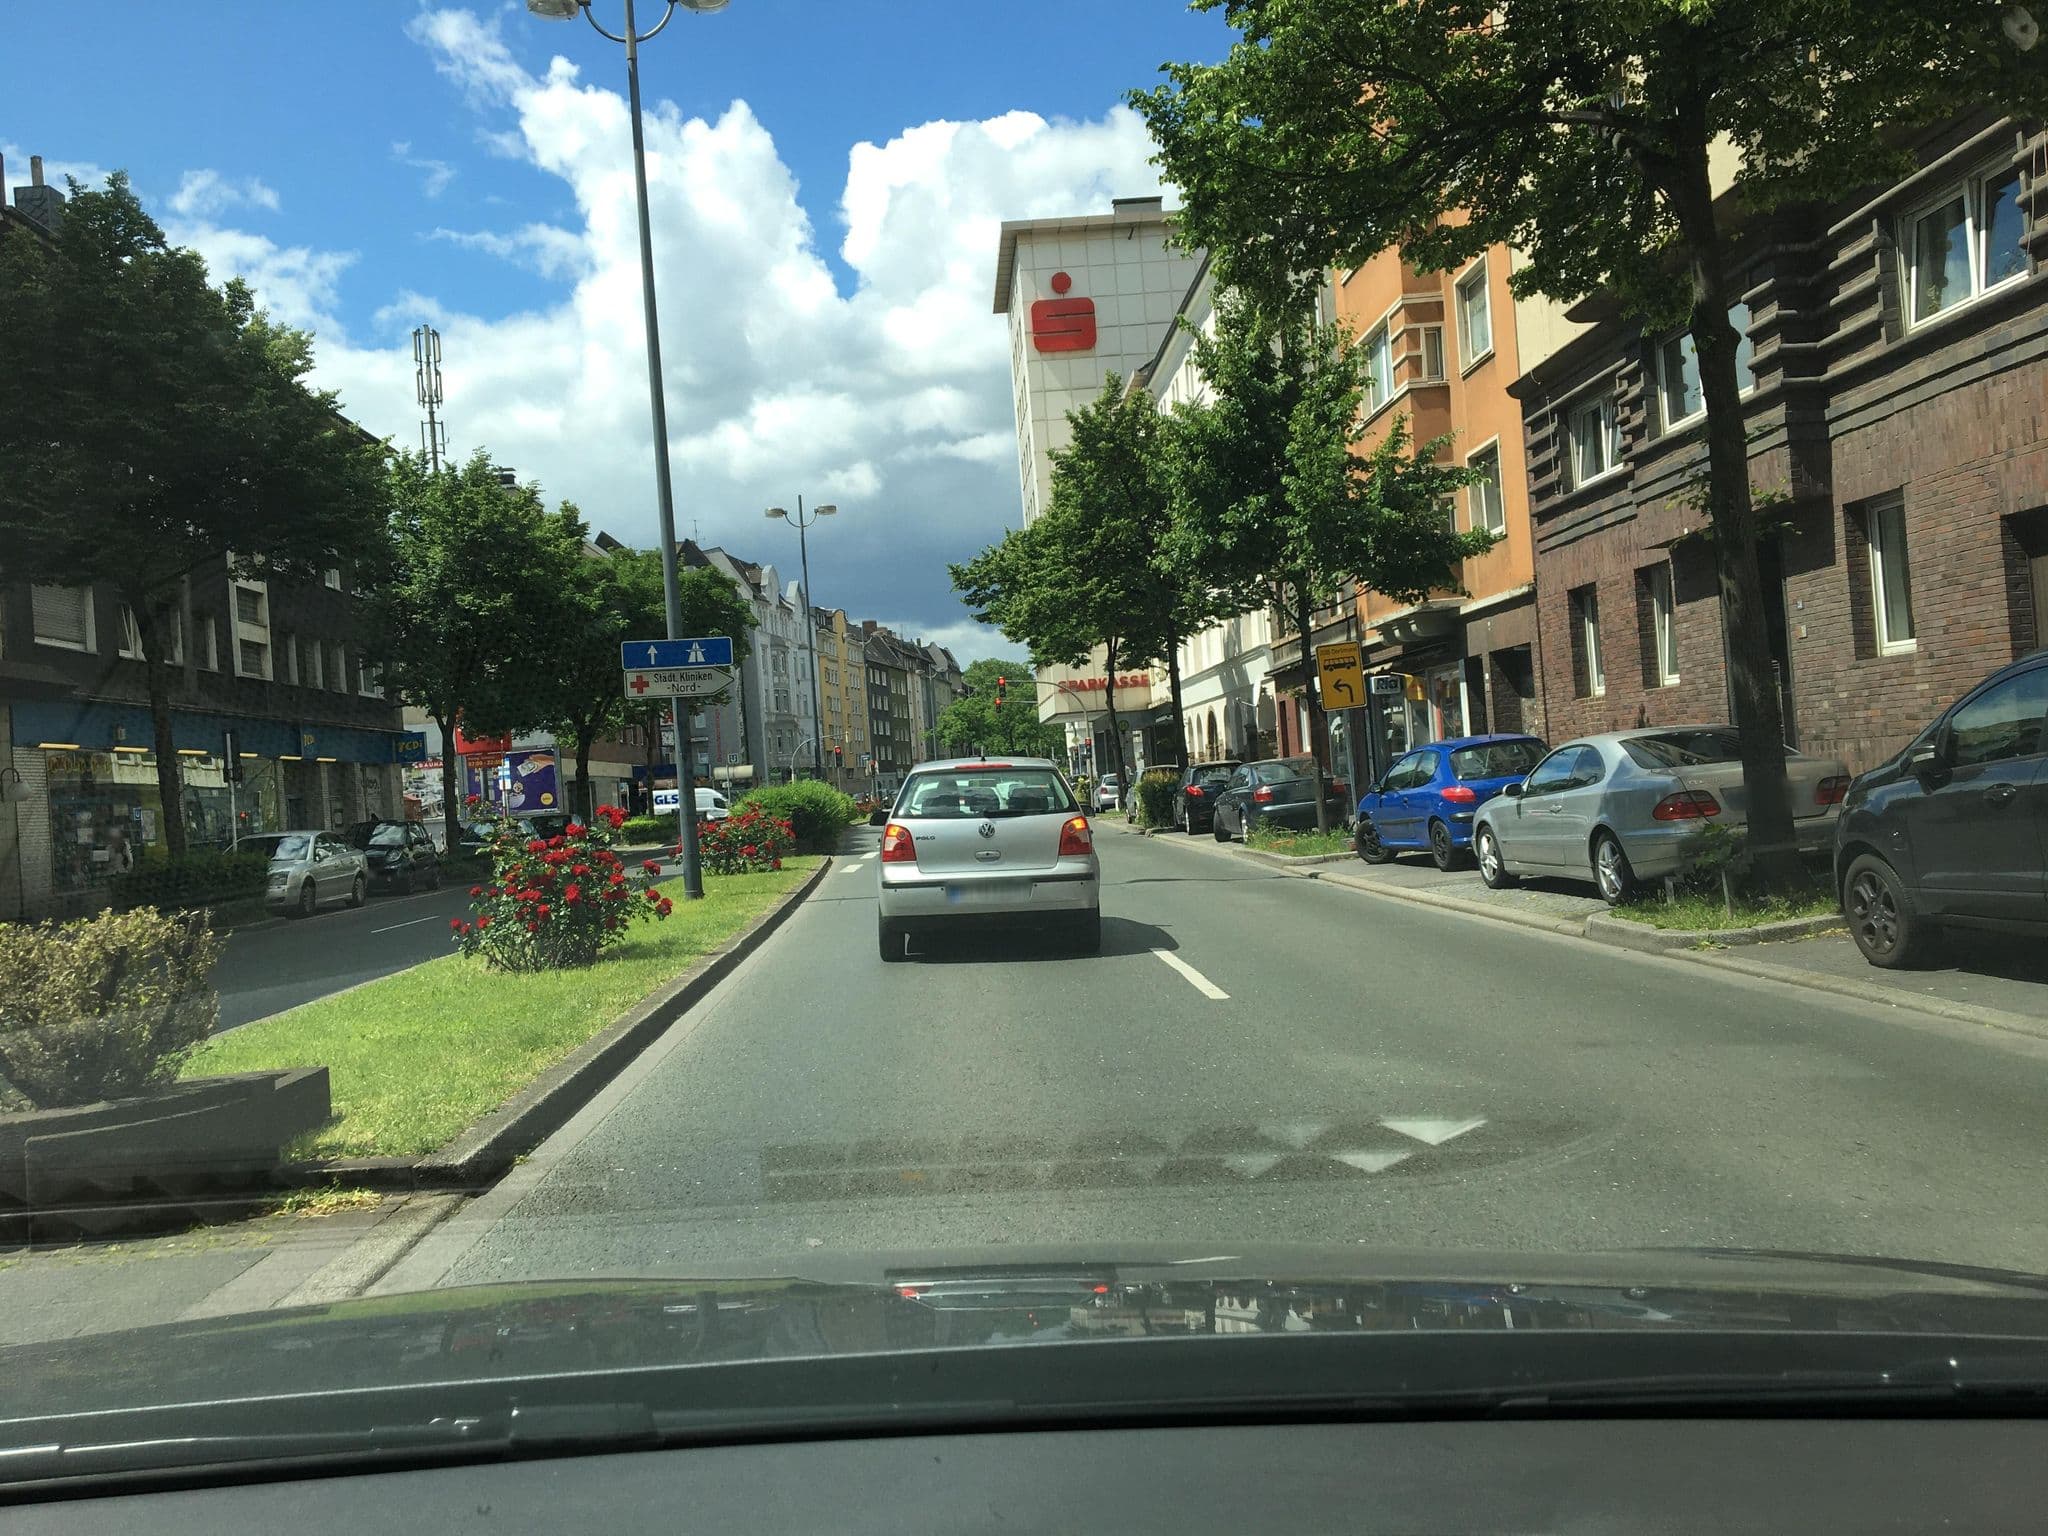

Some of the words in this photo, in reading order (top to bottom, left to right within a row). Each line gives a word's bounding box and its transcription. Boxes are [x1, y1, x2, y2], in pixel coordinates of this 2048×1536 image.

[679, 671, 713, 682] Kliniken
[1058, 674, 1149, 693] SPARKASSE
[654, 794, 679, 805] GLS
